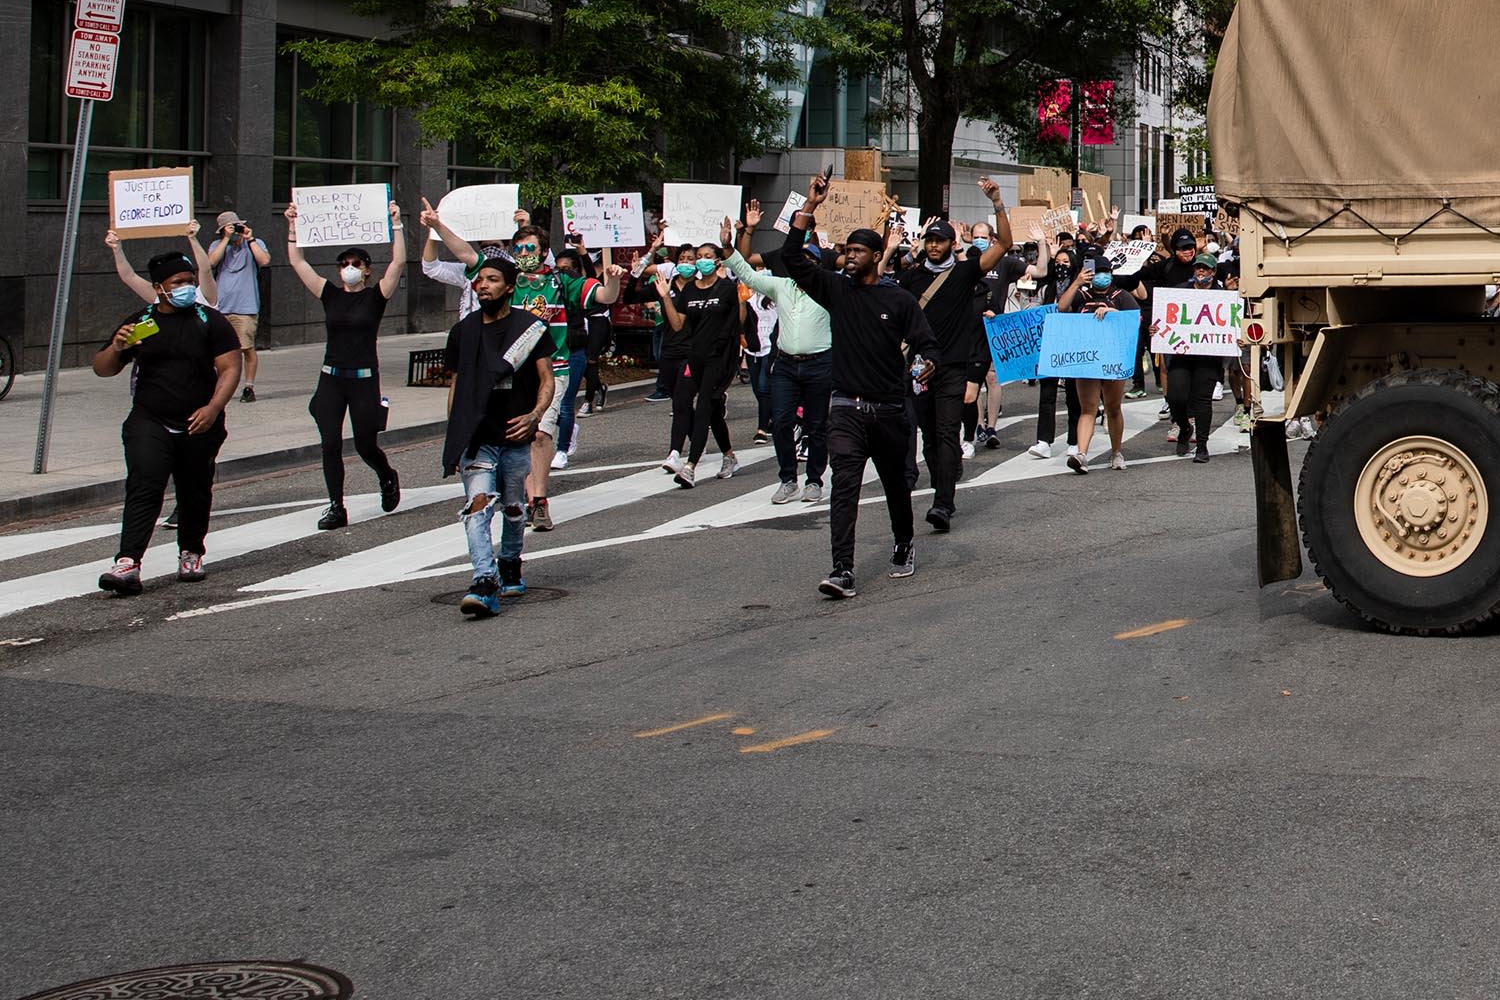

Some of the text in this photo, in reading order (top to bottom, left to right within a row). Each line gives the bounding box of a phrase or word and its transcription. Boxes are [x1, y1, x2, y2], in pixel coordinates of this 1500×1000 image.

[87, 2, 117, 12] ANYTIME
[80, 32, 113, 43] TOW AWAY
[90, 43, 101, 52] NO
[78, 51, 111, 62] STANDING
[82, 60, 111, 71] PARKING
[78, 69, 107, 79] ANYTIME
[124, 179, 174, 193] JUSTICE
[143, 192, 162, 203] FOR
[296, 192, 363, 206] LIBERTY
[1181, 194, 1193, 202] NO
[119, 203, 184, 222] GEORGE FLOYD
[334, 204, 361, 212] AND
[1182, 204, 1205, 212] STOP
[298, 212, 359, 226] JUSTICE
[336, 219, 362, 228] FOR
[1131, 240, 1155, 251] LIVES
[1110, 247, 1142, 256] MATTER
[1166, 302, 1242, 328] BLACK
[986, 314, 1018, 335] THERE
[1019, 309, 1043, 328] WAS
[991, 328, 1030, 351] CURFEW
[1152, 318, 1190, 355] LIVES
[1190, 332, 1233, 344] MATTER
[997, 342, 1030, 363] WHITE
[1050, 352, 1077, 369] BLACK
[1076, 350, 1100, 363] DICK
[1101, 362, 1124, 377] BLACK
